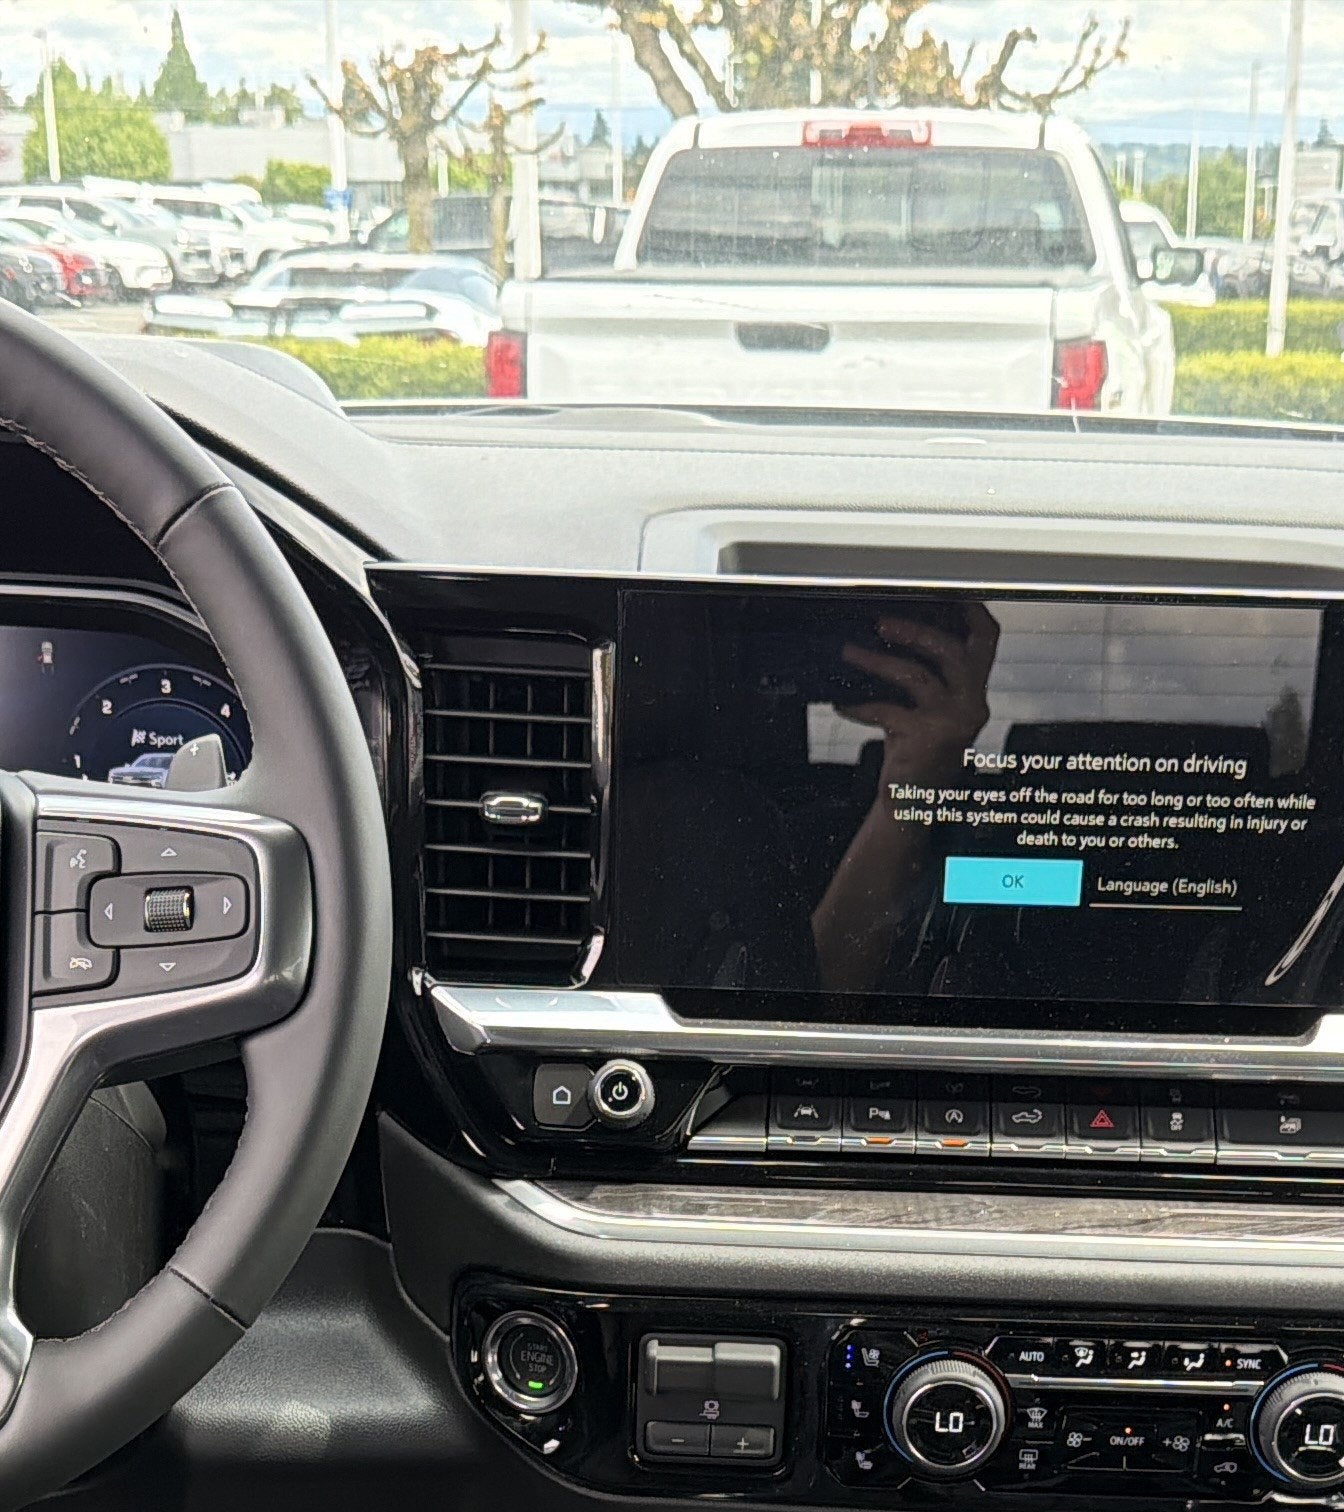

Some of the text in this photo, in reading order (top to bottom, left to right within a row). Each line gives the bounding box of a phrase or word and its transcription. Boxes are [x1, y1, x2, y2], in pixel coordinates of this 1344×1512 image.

[160, 678, 172, 694] 3
[102, 699, 113, 715] 2
[220, 703, 231, 719] 4
[149, 731, 185, 749] Sport
[74, 754, 81, 769] 1
[963, 749, 1248, 780] Focus your attention on driving
[888, 784, 1316, 811] Taking your eyes off the road for too long or too often while
[894, 806, 1308, 834] using this system could cause a crash resulting in injury or
[1017, 830, 1179, 850] death to you or others.
[1002, 874, 1025, 889] OK
[1097, 877, 1238, 897] Language (English)
[520, 1350, 554, 1367] ENGINE
[1019, 1350, 1045, 1362] AUTO
[1236, 1358, 1262, 1370] SYNC
[528, 1363, 547, 1373] STOP
[935, 1412, 964, 1433] LO
[1216, 1418, 1234, 1429] A/C
[1109, 1436, 1145, 1447] ON/OFF
[1305, 1424, 1335, 1446] LO
